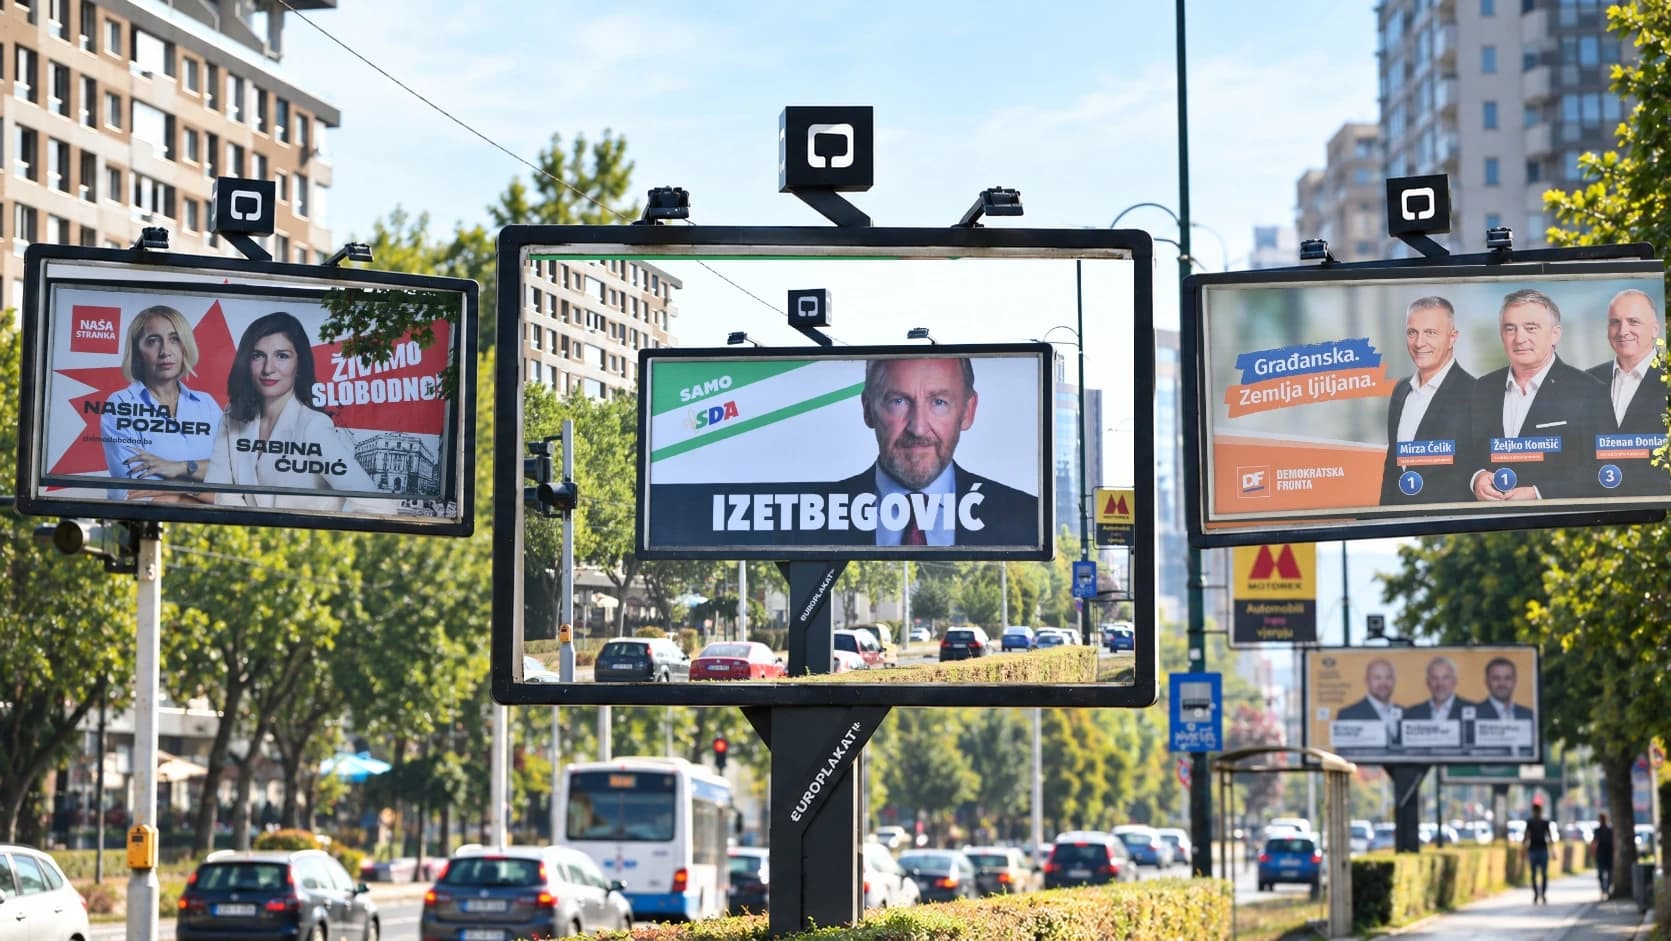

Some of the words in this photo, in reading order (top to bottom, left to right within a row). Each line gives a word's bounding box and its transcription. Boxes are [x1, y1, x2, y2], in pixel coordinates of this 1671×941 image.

[80, 319, 114, 331] NAŠA
[76, 330, 116, 340] STRANKA
[1254, 347, 1360, 375] Građanska.
[680, 375, 733, 402] SAMO
[1239, 380, 1303, 406] Zemlja
[1308, 374, 1377, 399] ljiljana.
[84, 401, 171, 418] NASIHA
[695, 400, 739, 430] SDA
[116, 418, 211, 435] POZDER
[236, 438, 323, 457] SABINA
[1400, 443, 1426, 454] Mirza
[1427, 441, 1452, 453] Čelik
[1493, 438, 1523, 452] Željko
[1525, 438, 1559, 450] Komšić
[1599, 436, 1633, 448] Dženan
[274, 455, 348, 476] ĆUDIĆ
[1276, 466, 1345, 480] DEMOKRATSKA
[1242, 470, 1265, 489] DF
[1407, 476, 1415, 489] 1
[1501, 473, 1508, 486] 1
[1605, 469, 1615, 482] 3
[1276, 480, 1313, 491] FRONTA
[712, 482, 986, 532] IZETBEGOVIĆ
[790, 728, 857, 822] EUROPLAKAT
